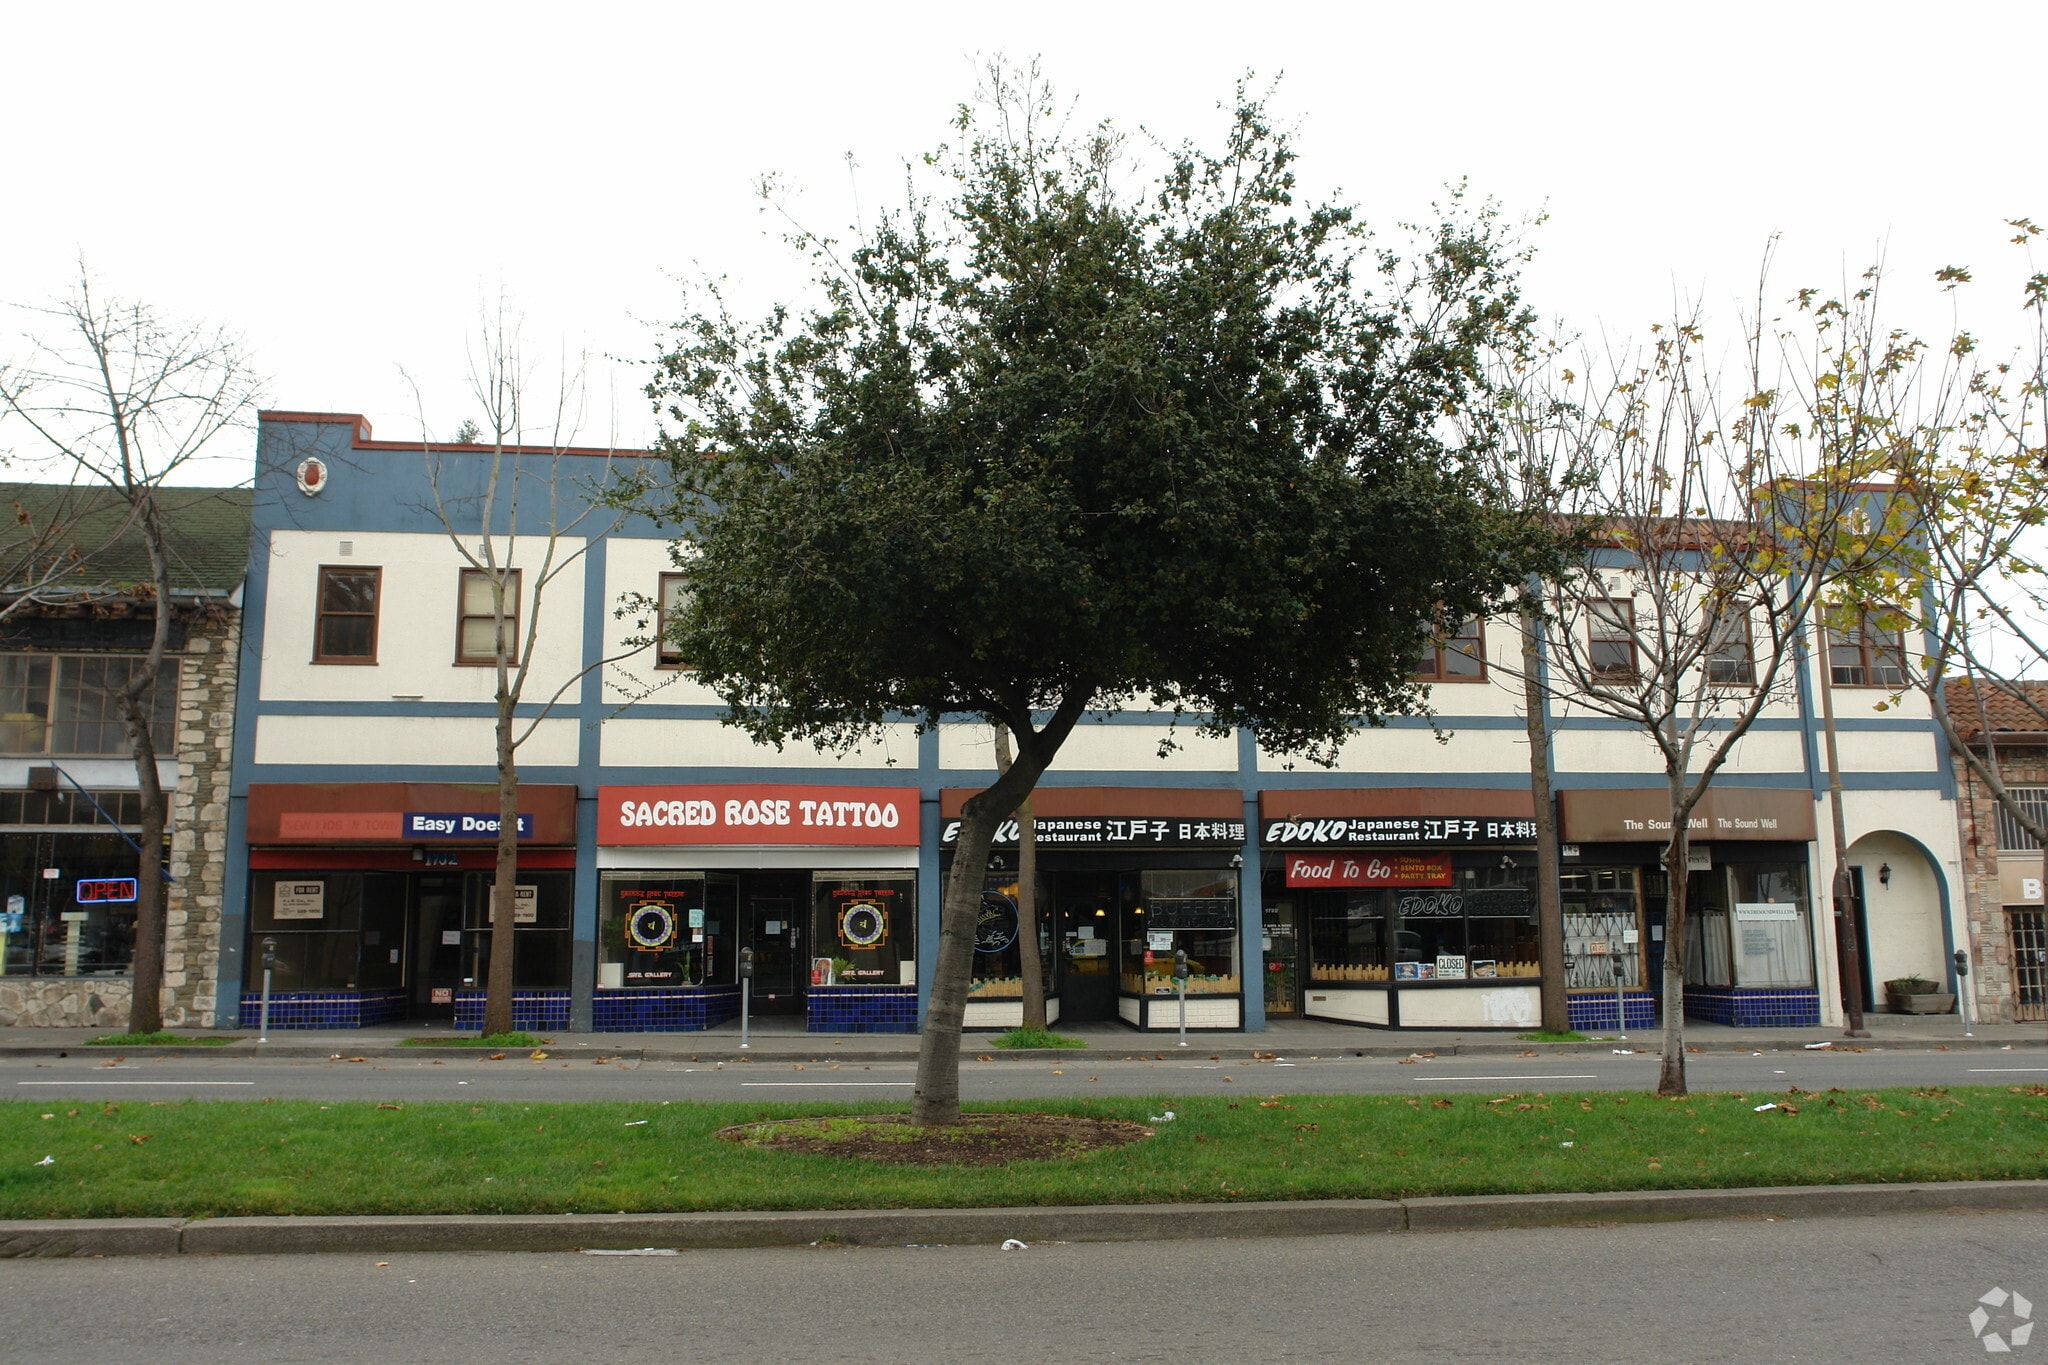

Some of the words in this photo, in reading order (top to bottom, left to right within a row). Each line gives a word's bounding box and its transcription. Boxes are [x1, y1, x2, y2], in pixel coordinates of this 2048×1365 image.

[620, 800, 717, 827] SACRED
[724, 799, 791, 826] ROSE
[799, 800, 899, 828] TATTOO
[412, 816, 456, 834] Easy
[462, 816, 501, 831] Doe
[942, 819, 1020, 843] EKO
[1178, 822, 1246, 841] 日本料理
[1265, 820, 1347, 843] EDOKO
[1348, 819, 1419, 831] Japanese
[1623, 819, 1644, 830] The
[1717, 818, 1733, 829] The
[1734, 818, 1758, 829] Sound
[1760, 818, 1778, 829] Well
[1034, 833, 1102, 842] estaurant
[1348, 831, 1420, 842] Restaurant
[1290, 860, 1333, 879] Food
[1342, 860, 1360, 879] To
[1366, 859, 1391, 879] Go
[80, 882, 134, 900] OPEN
[1398, 893, 1464, 916] EDOKO
[1438, 958, 1464, 969] CLOSED
[435, 989, 448, 997] NO
